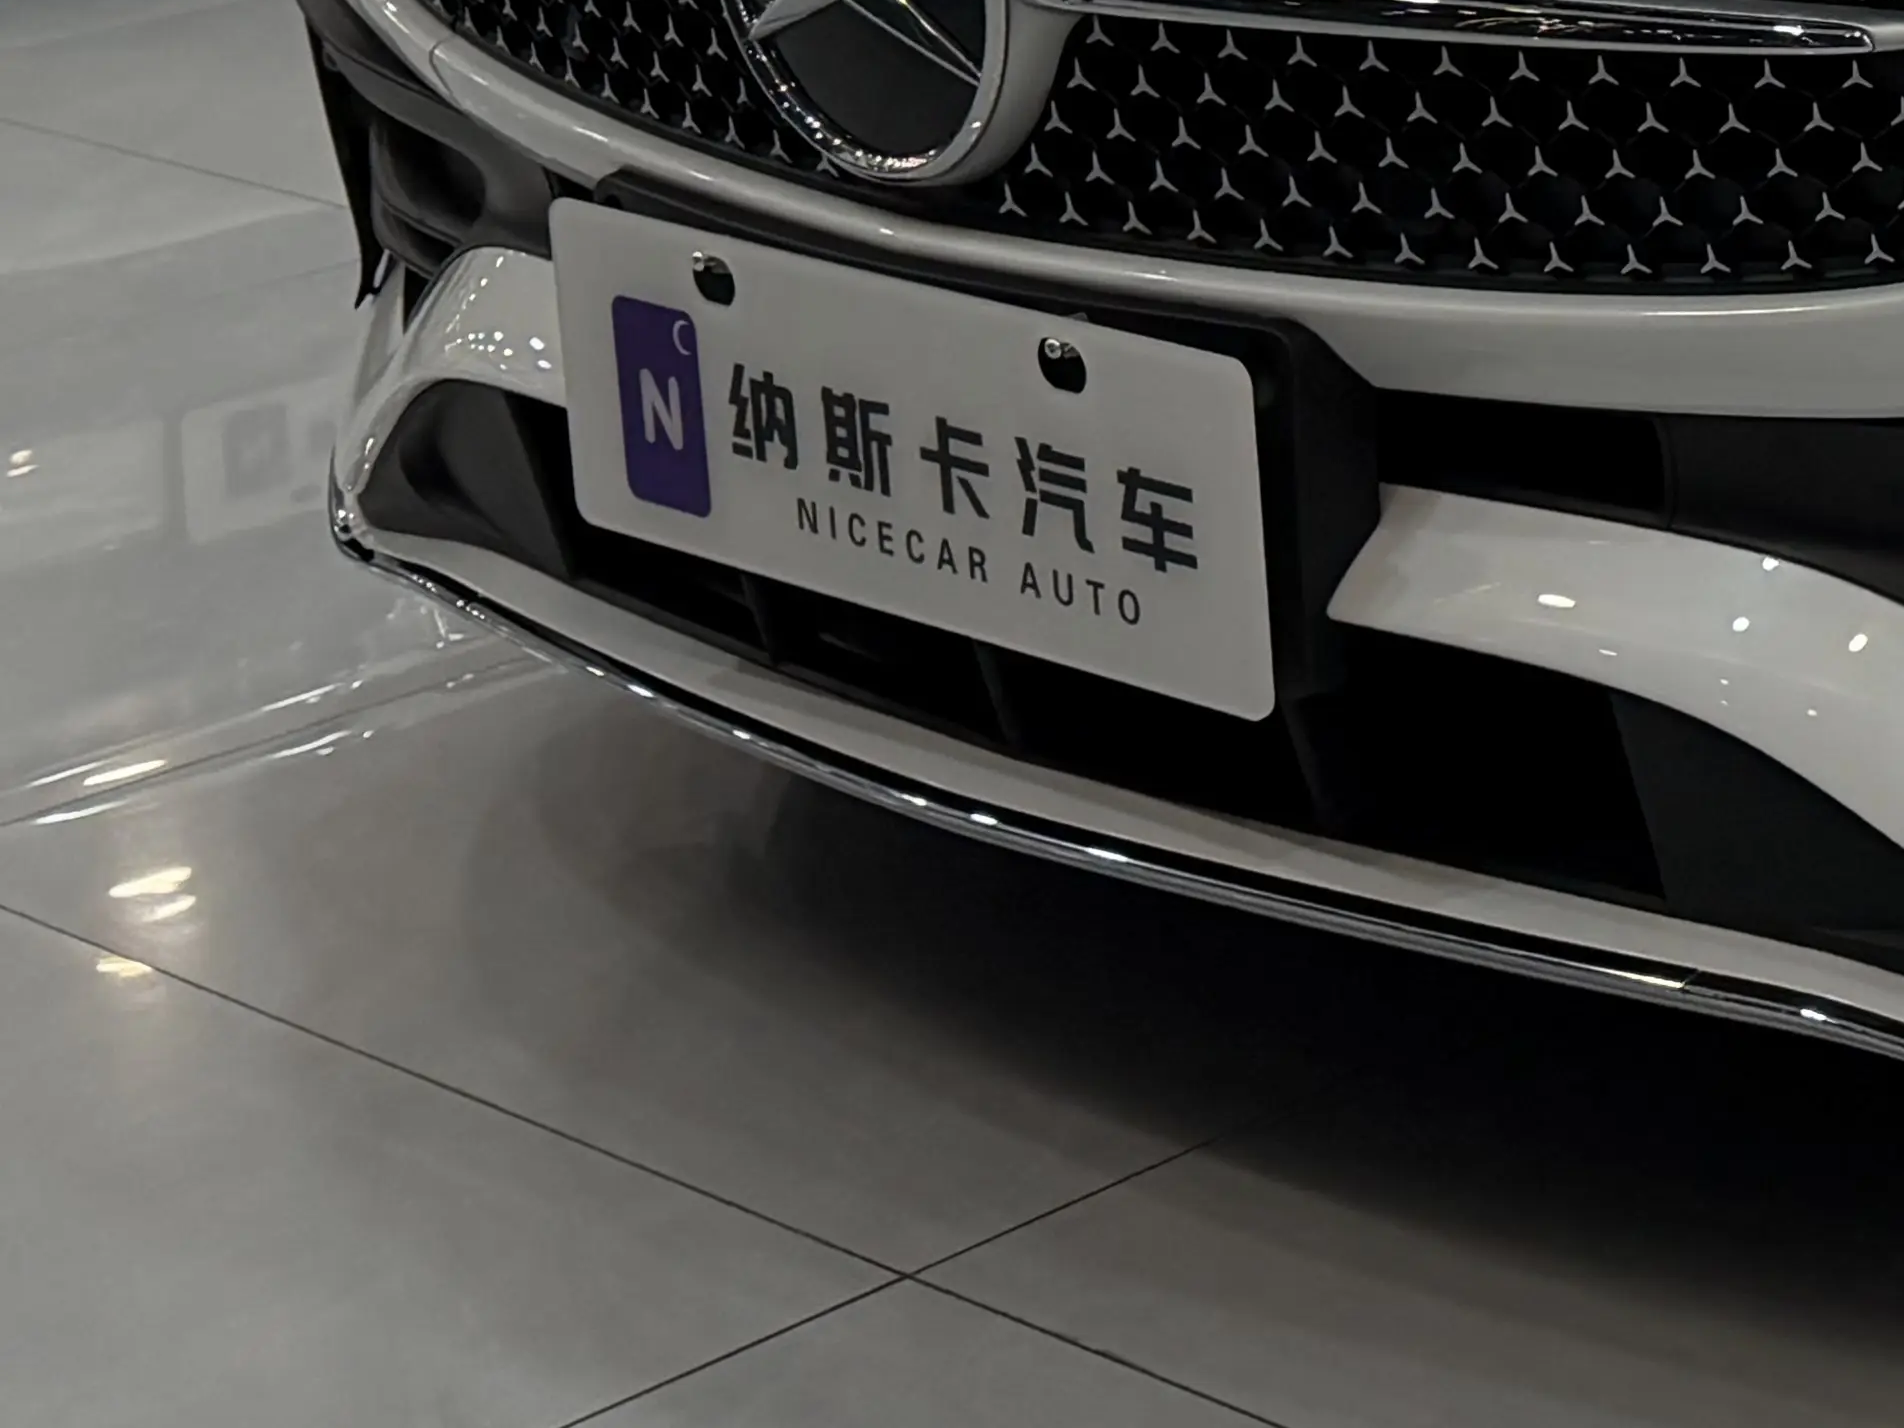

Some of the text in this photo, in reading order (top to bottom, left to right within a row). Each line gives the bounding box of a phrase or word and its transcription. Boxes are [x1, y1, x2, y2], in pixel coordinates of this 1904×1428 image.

[728, 362, 1199, 574] 纳斯卡汽车
[797, 497, 1141, 626] NICECAR AUTO
